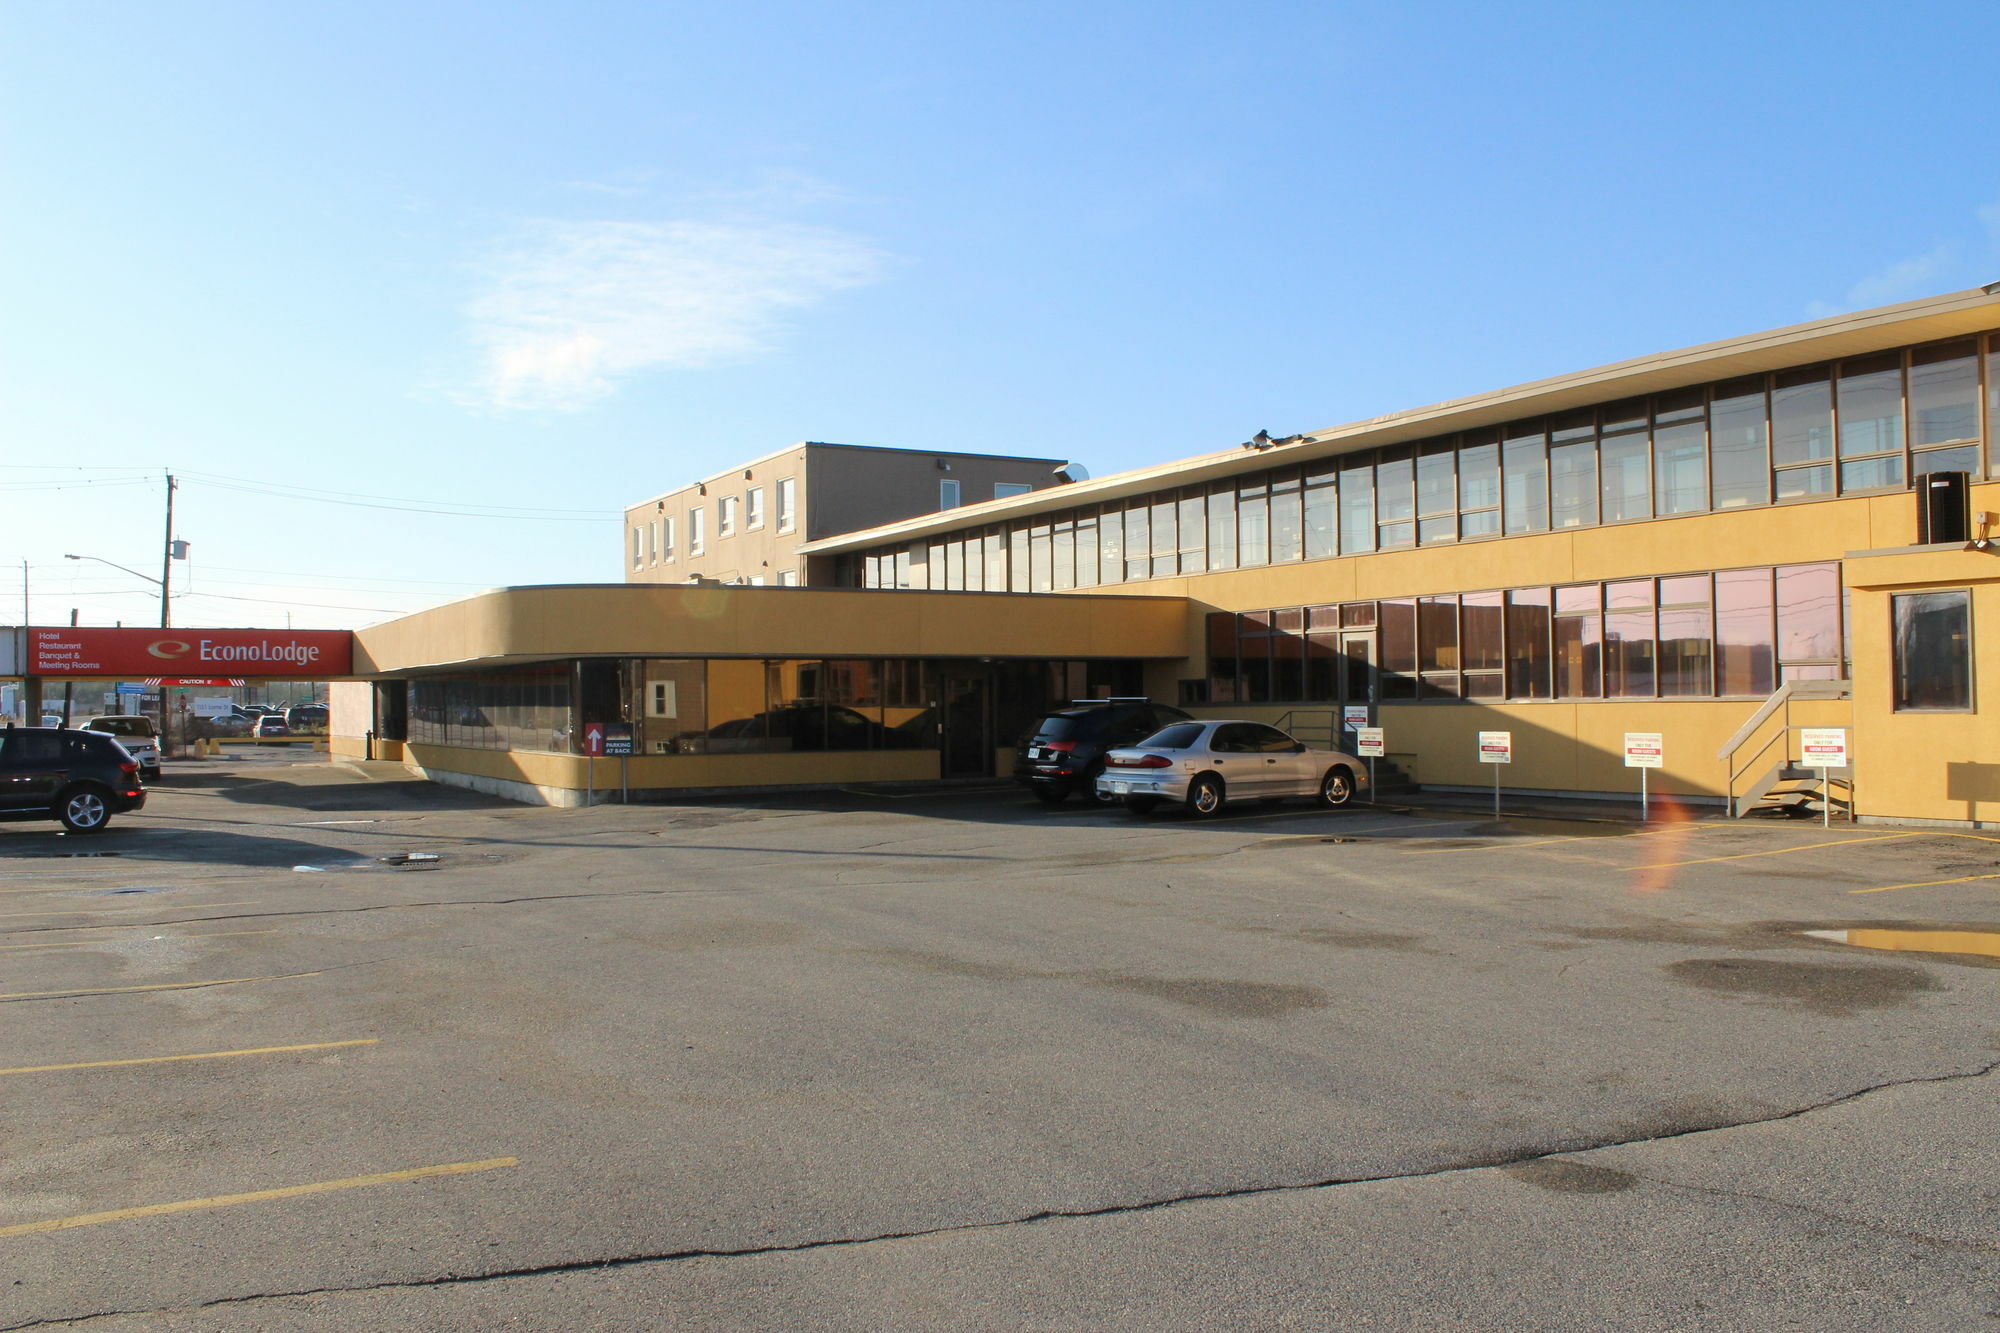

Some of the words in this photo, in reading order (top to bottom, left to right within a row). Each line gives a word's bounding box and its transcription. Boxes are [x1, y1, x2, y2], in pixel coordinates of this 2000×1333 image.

[39, 632, 60, 640] Hotel
[39, 652, 72, 660] Banquet
[39, 662, 70, 670] Meeting
